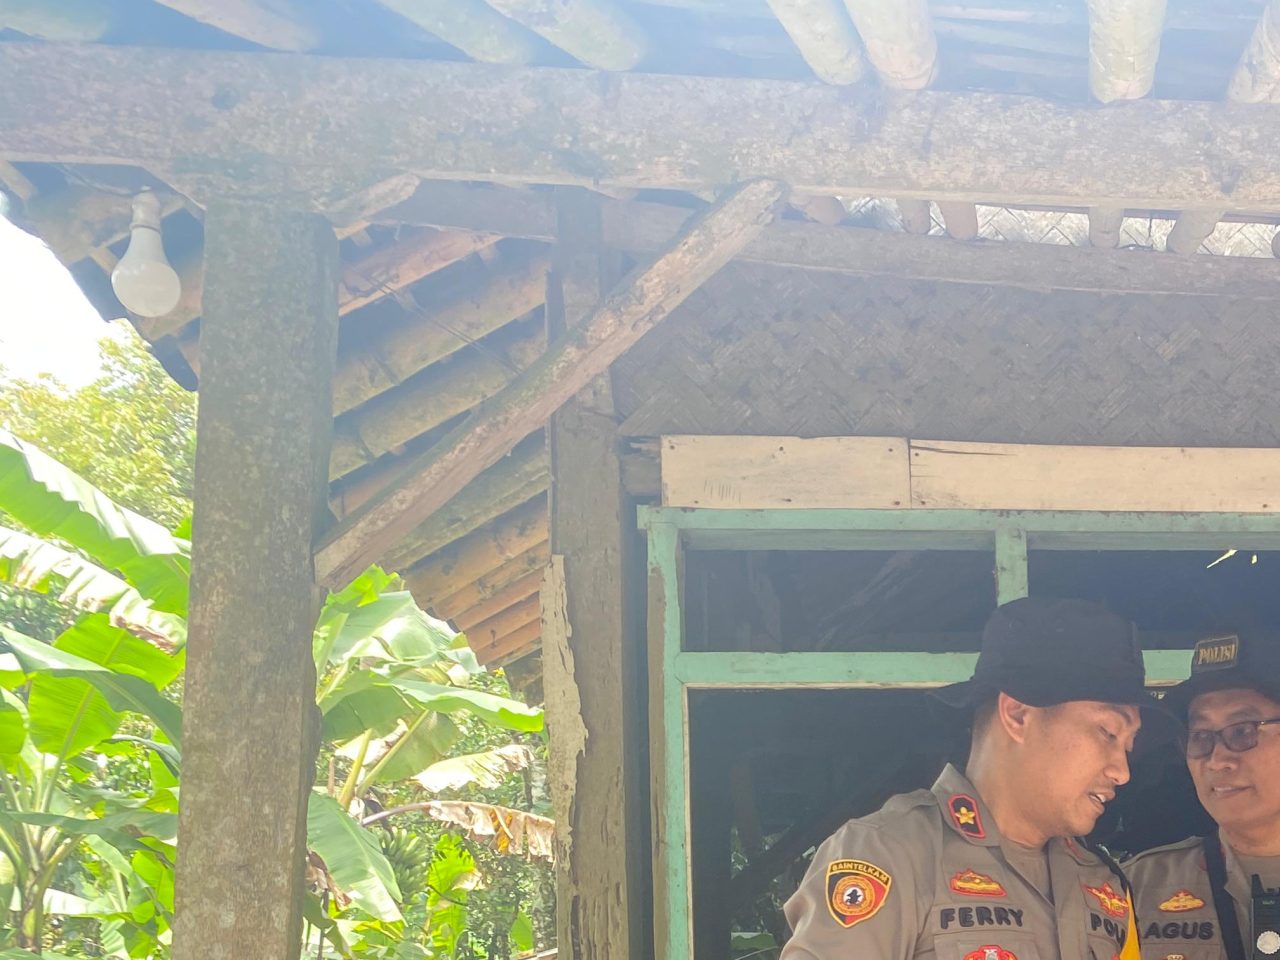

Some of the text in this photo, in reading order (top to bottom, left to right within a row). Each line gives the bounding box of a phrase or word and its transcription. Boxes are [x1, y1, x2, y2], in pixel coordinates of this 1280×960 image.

[1197, 644, 1236, 665] POLISI
[831, 861, 888, 883] BAINTELKAM
[940, 906, 1023, 930] FERRY
[1143, 921, 1214, 941] AGUS
